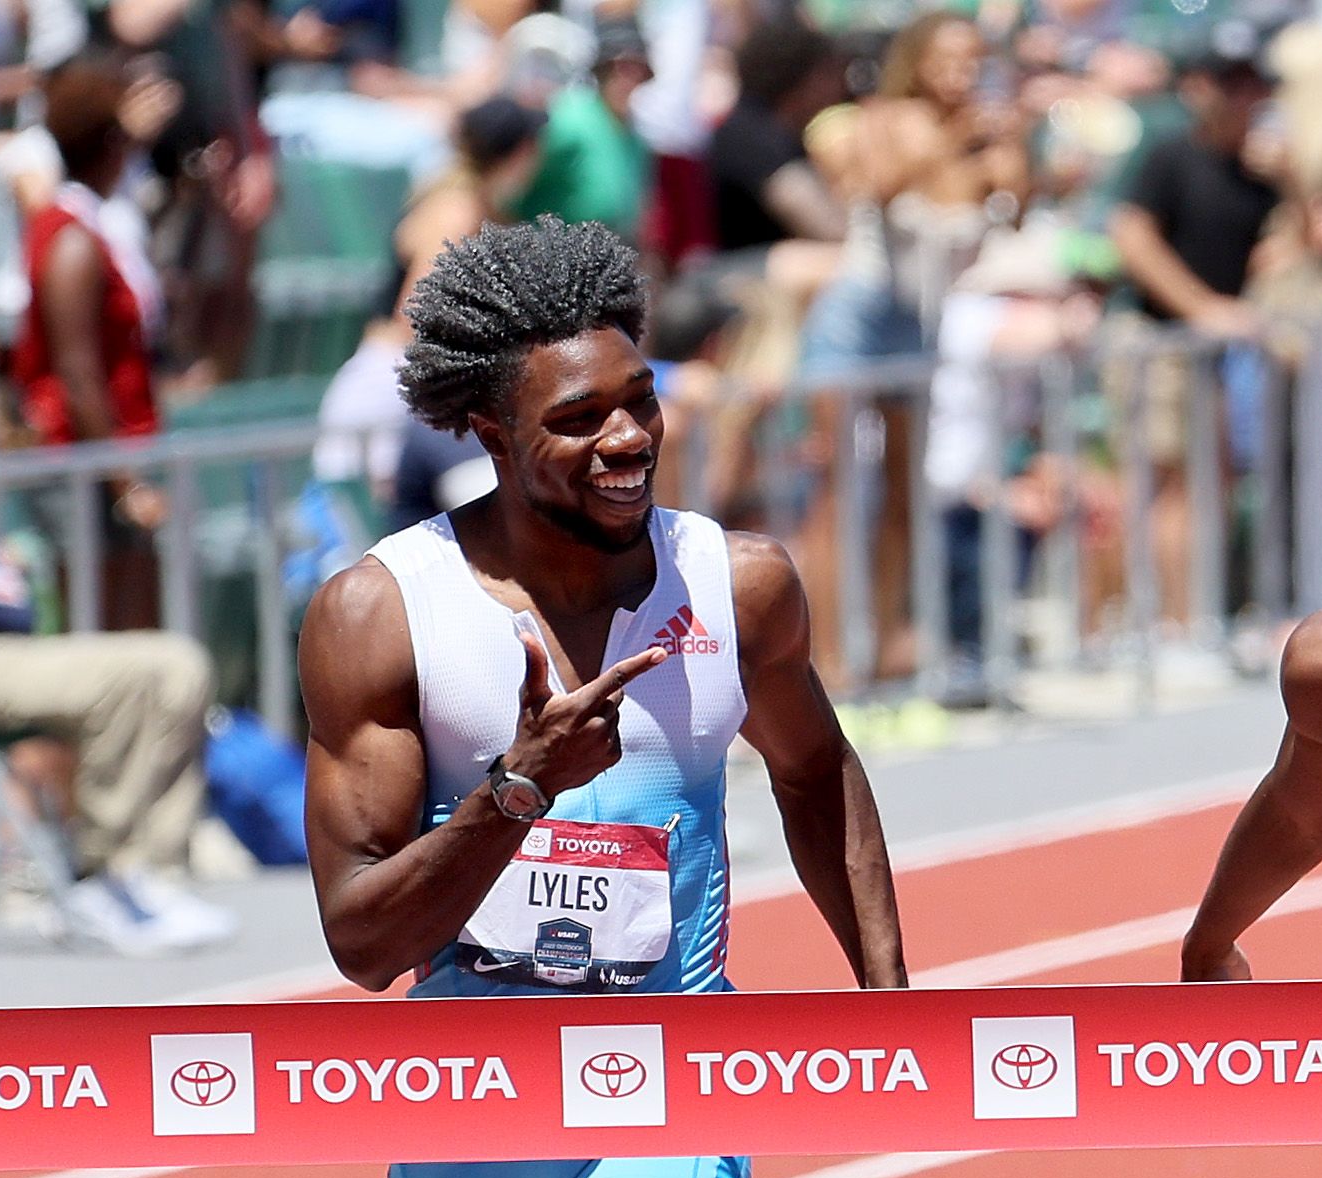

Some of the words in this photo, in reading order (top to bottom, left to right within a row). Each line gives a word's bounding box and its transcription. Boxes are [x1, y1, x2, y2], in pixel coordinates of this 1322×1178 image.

[556, 838, 622, 855] TOYOTA
[528, 871, 610, 912] LYLES
[276, 1057, 517, 1103] TOYOTA
[687, 1049, 928, 1095] TOYOTA
